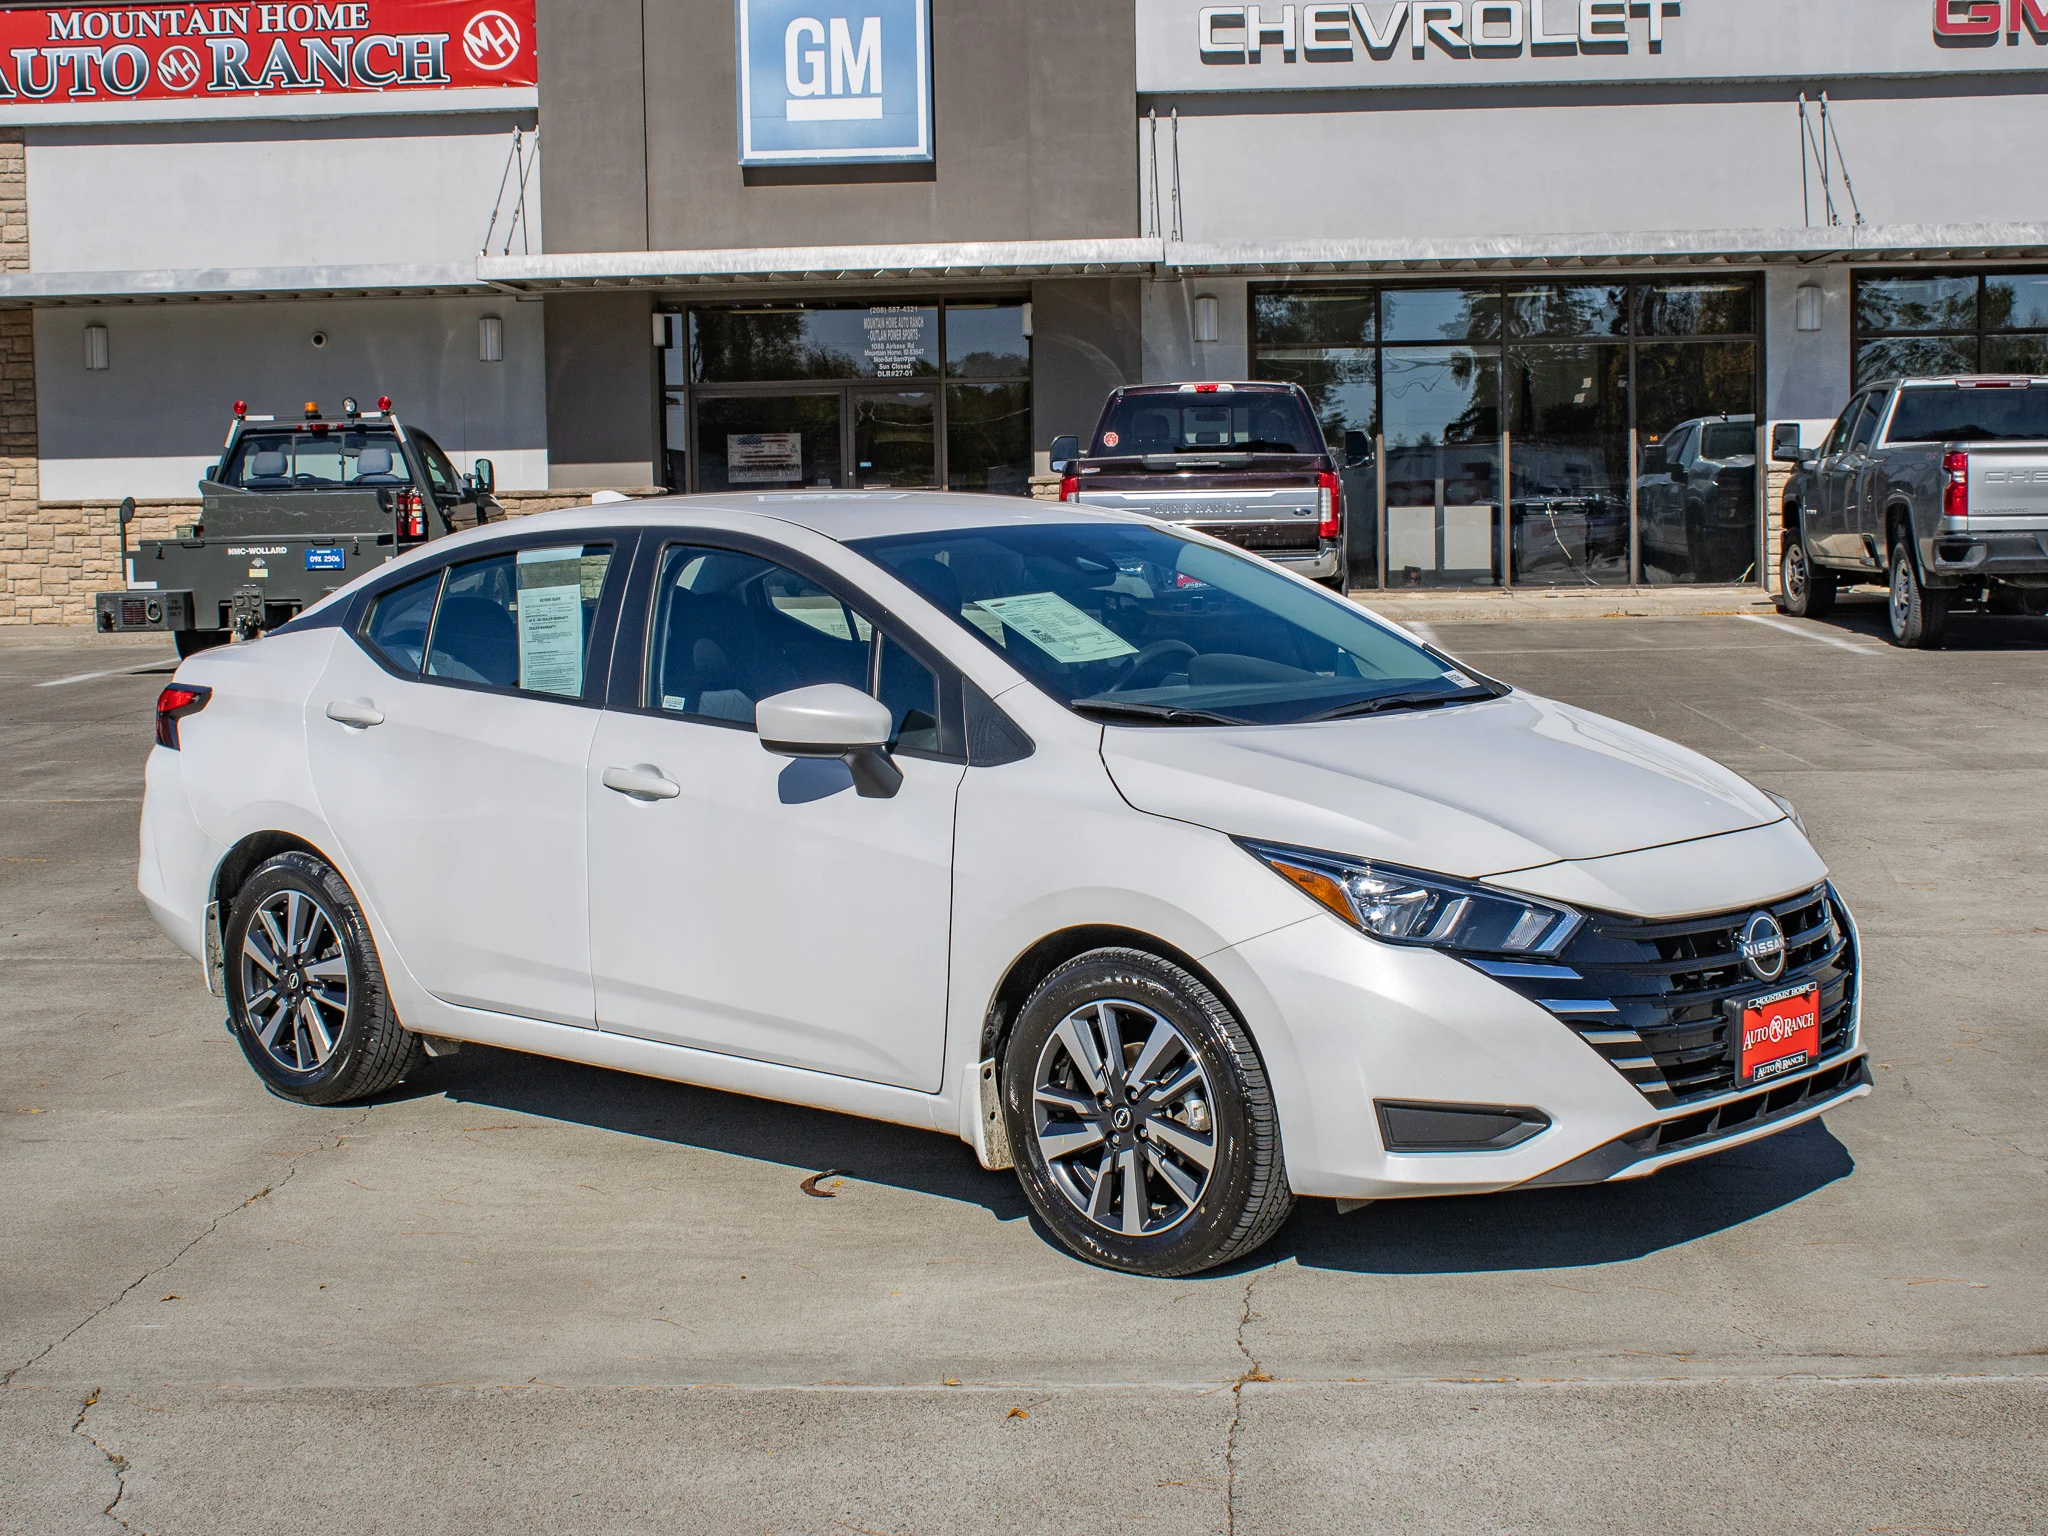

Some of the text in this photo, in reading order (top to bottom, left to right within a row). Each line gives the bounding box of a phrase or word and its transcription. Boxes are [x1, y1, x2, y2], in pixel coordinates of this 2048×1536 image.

[47, 1, 371, 41] MOUNTAIN HOME
[1198, 0, 1680, 53] CHEVROLET
[206, 34, 450, 91] RANCH
[784, 16, 883, 97] GM
[863, 316, 924, 329] MOUNTAIN HOME AUTO RANCH
[869, 328, 919, 341] OUTLAW POWER SPORTS
[886, 342, 906, 350] Airbase
[1984, 471, 2048, 484] CHE
[1154, 502, 1243, 514] KING RANCH
[227, 547, 288, 556] NMC-WOLLARD
[323, 555, 341, 563] 2506
[1743, 937, 1785, 957] NISSAN
[1742, 1026, 1769, 1051] AUTO
[1783, 1012, 1815, 1038] RANCH
[1757, 1064, 1775, 1078] AUTO
[1782, 1056, 1804, 1070] RANCH
